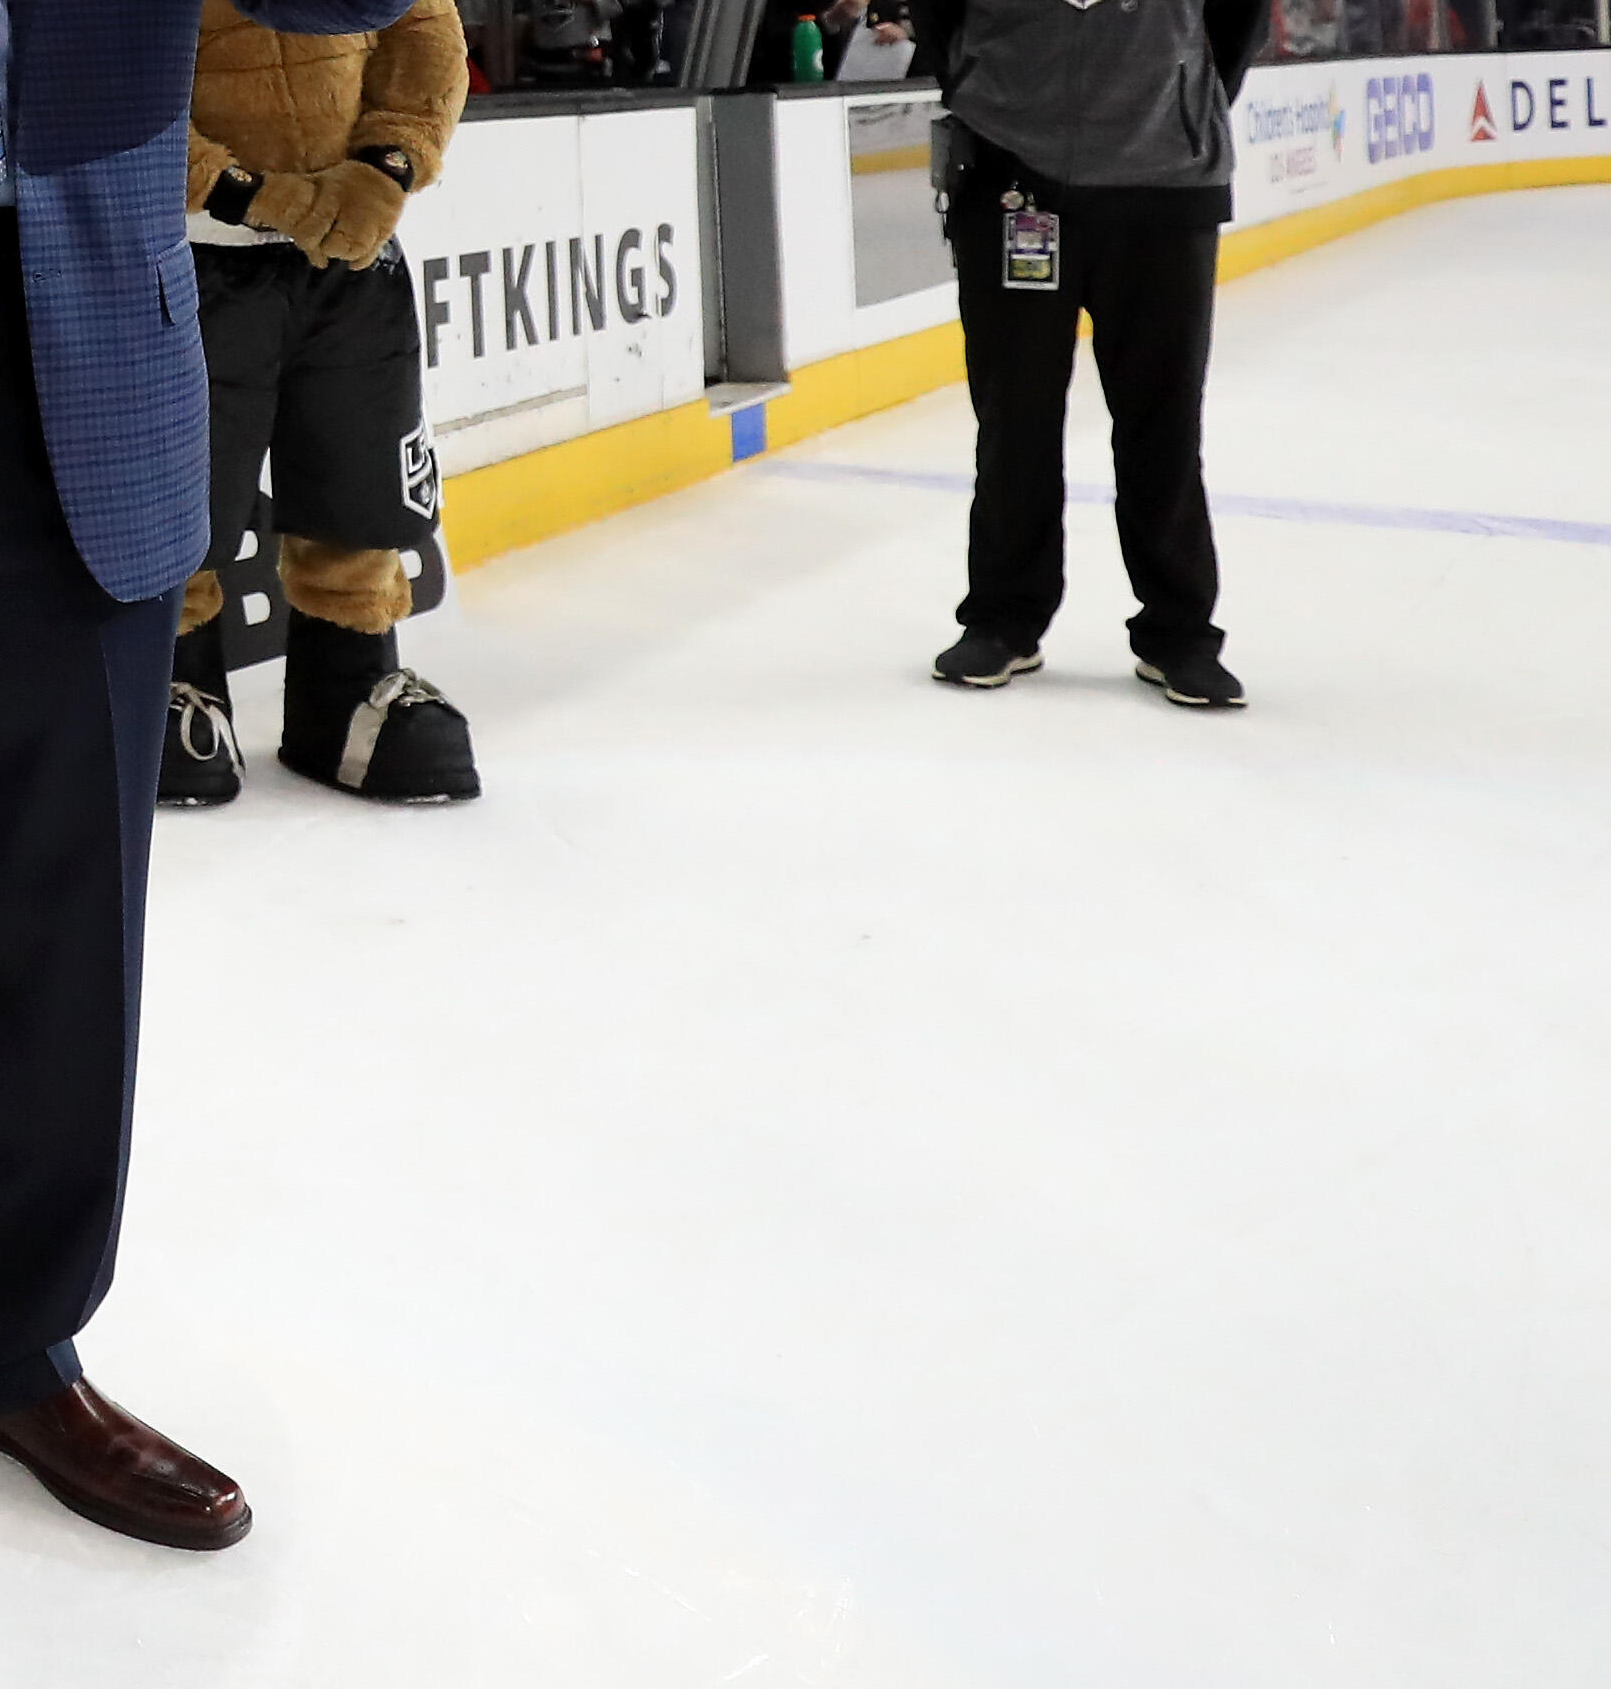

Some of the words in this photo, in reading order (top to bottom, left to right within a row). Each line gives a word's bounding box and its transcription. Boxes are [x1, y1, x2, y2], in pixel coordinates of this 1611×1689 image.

[1366, 71, 1436, 165] GEICO
[1510, 77, 1609, 132] DEL
[422, 221, 678, 369] FTKINGS
